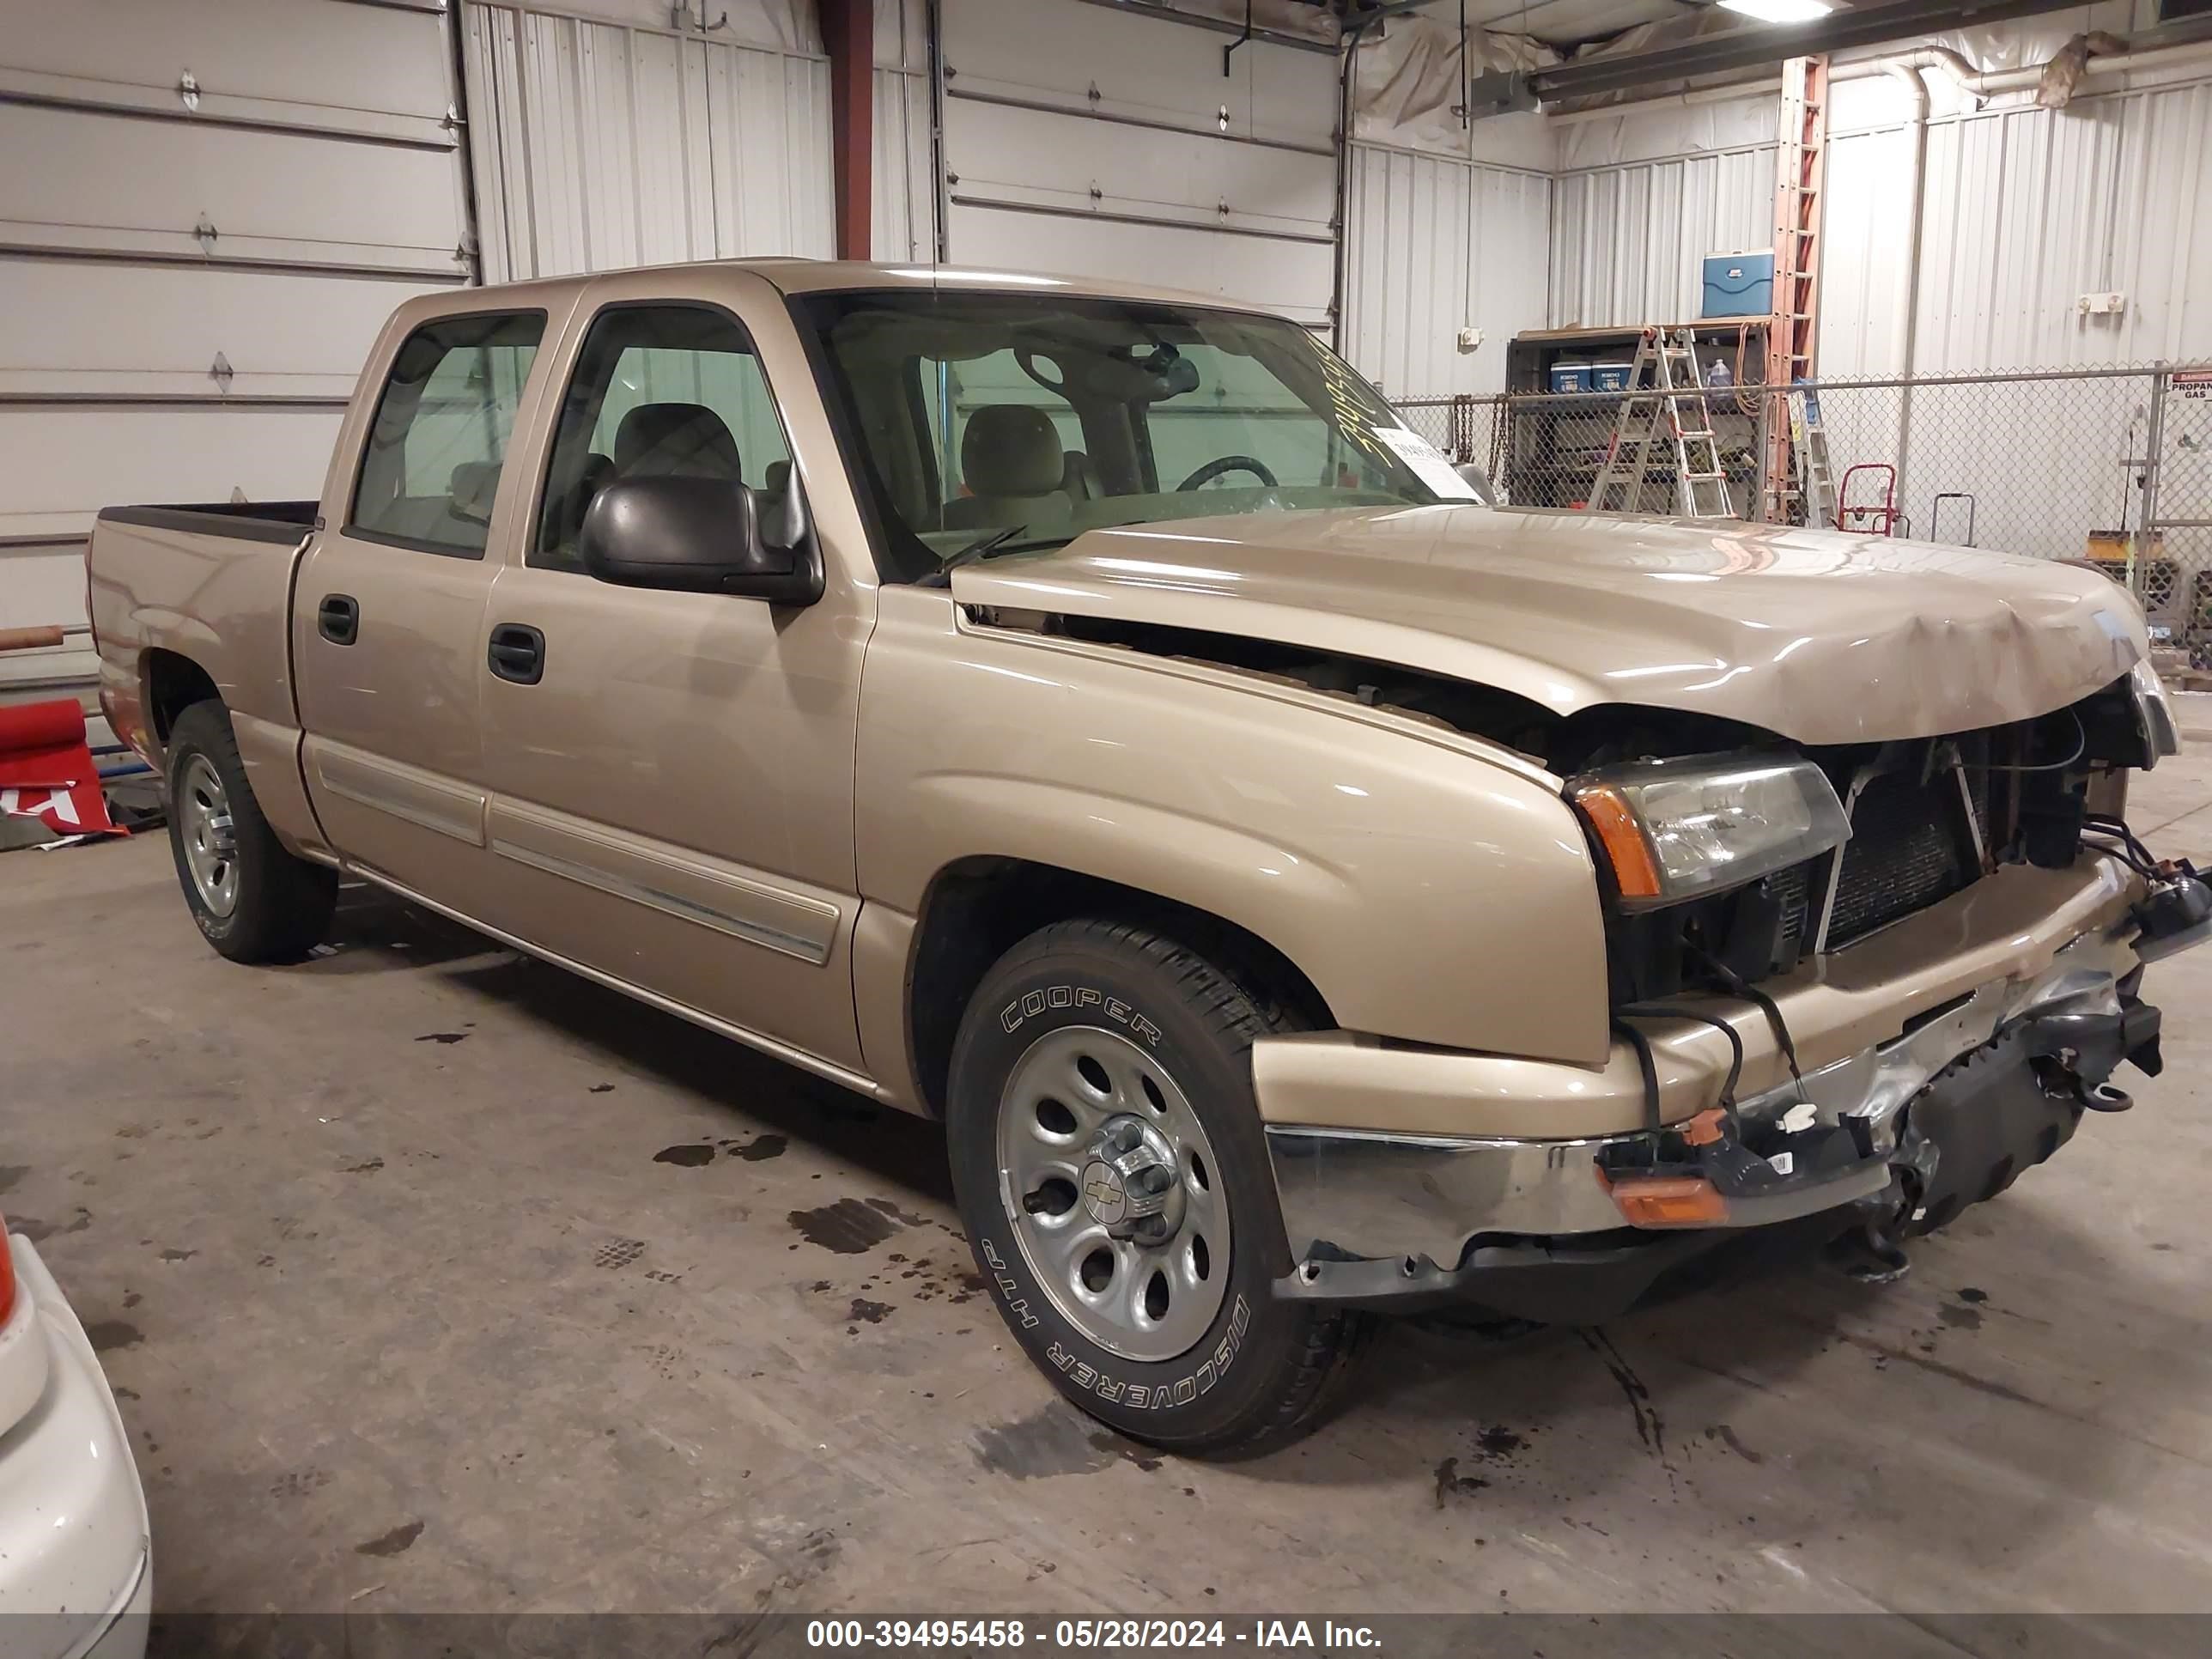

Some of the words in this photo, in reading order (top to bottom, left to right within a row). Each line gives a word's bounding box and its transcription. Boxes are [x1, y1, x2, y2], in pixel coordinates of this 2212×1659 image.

[1000, 985, 1162, 1047] COOPER
[981, 1238, 1040, 1329] HTP
[1045, 1293, 1251, 1410] DISCOVERER
